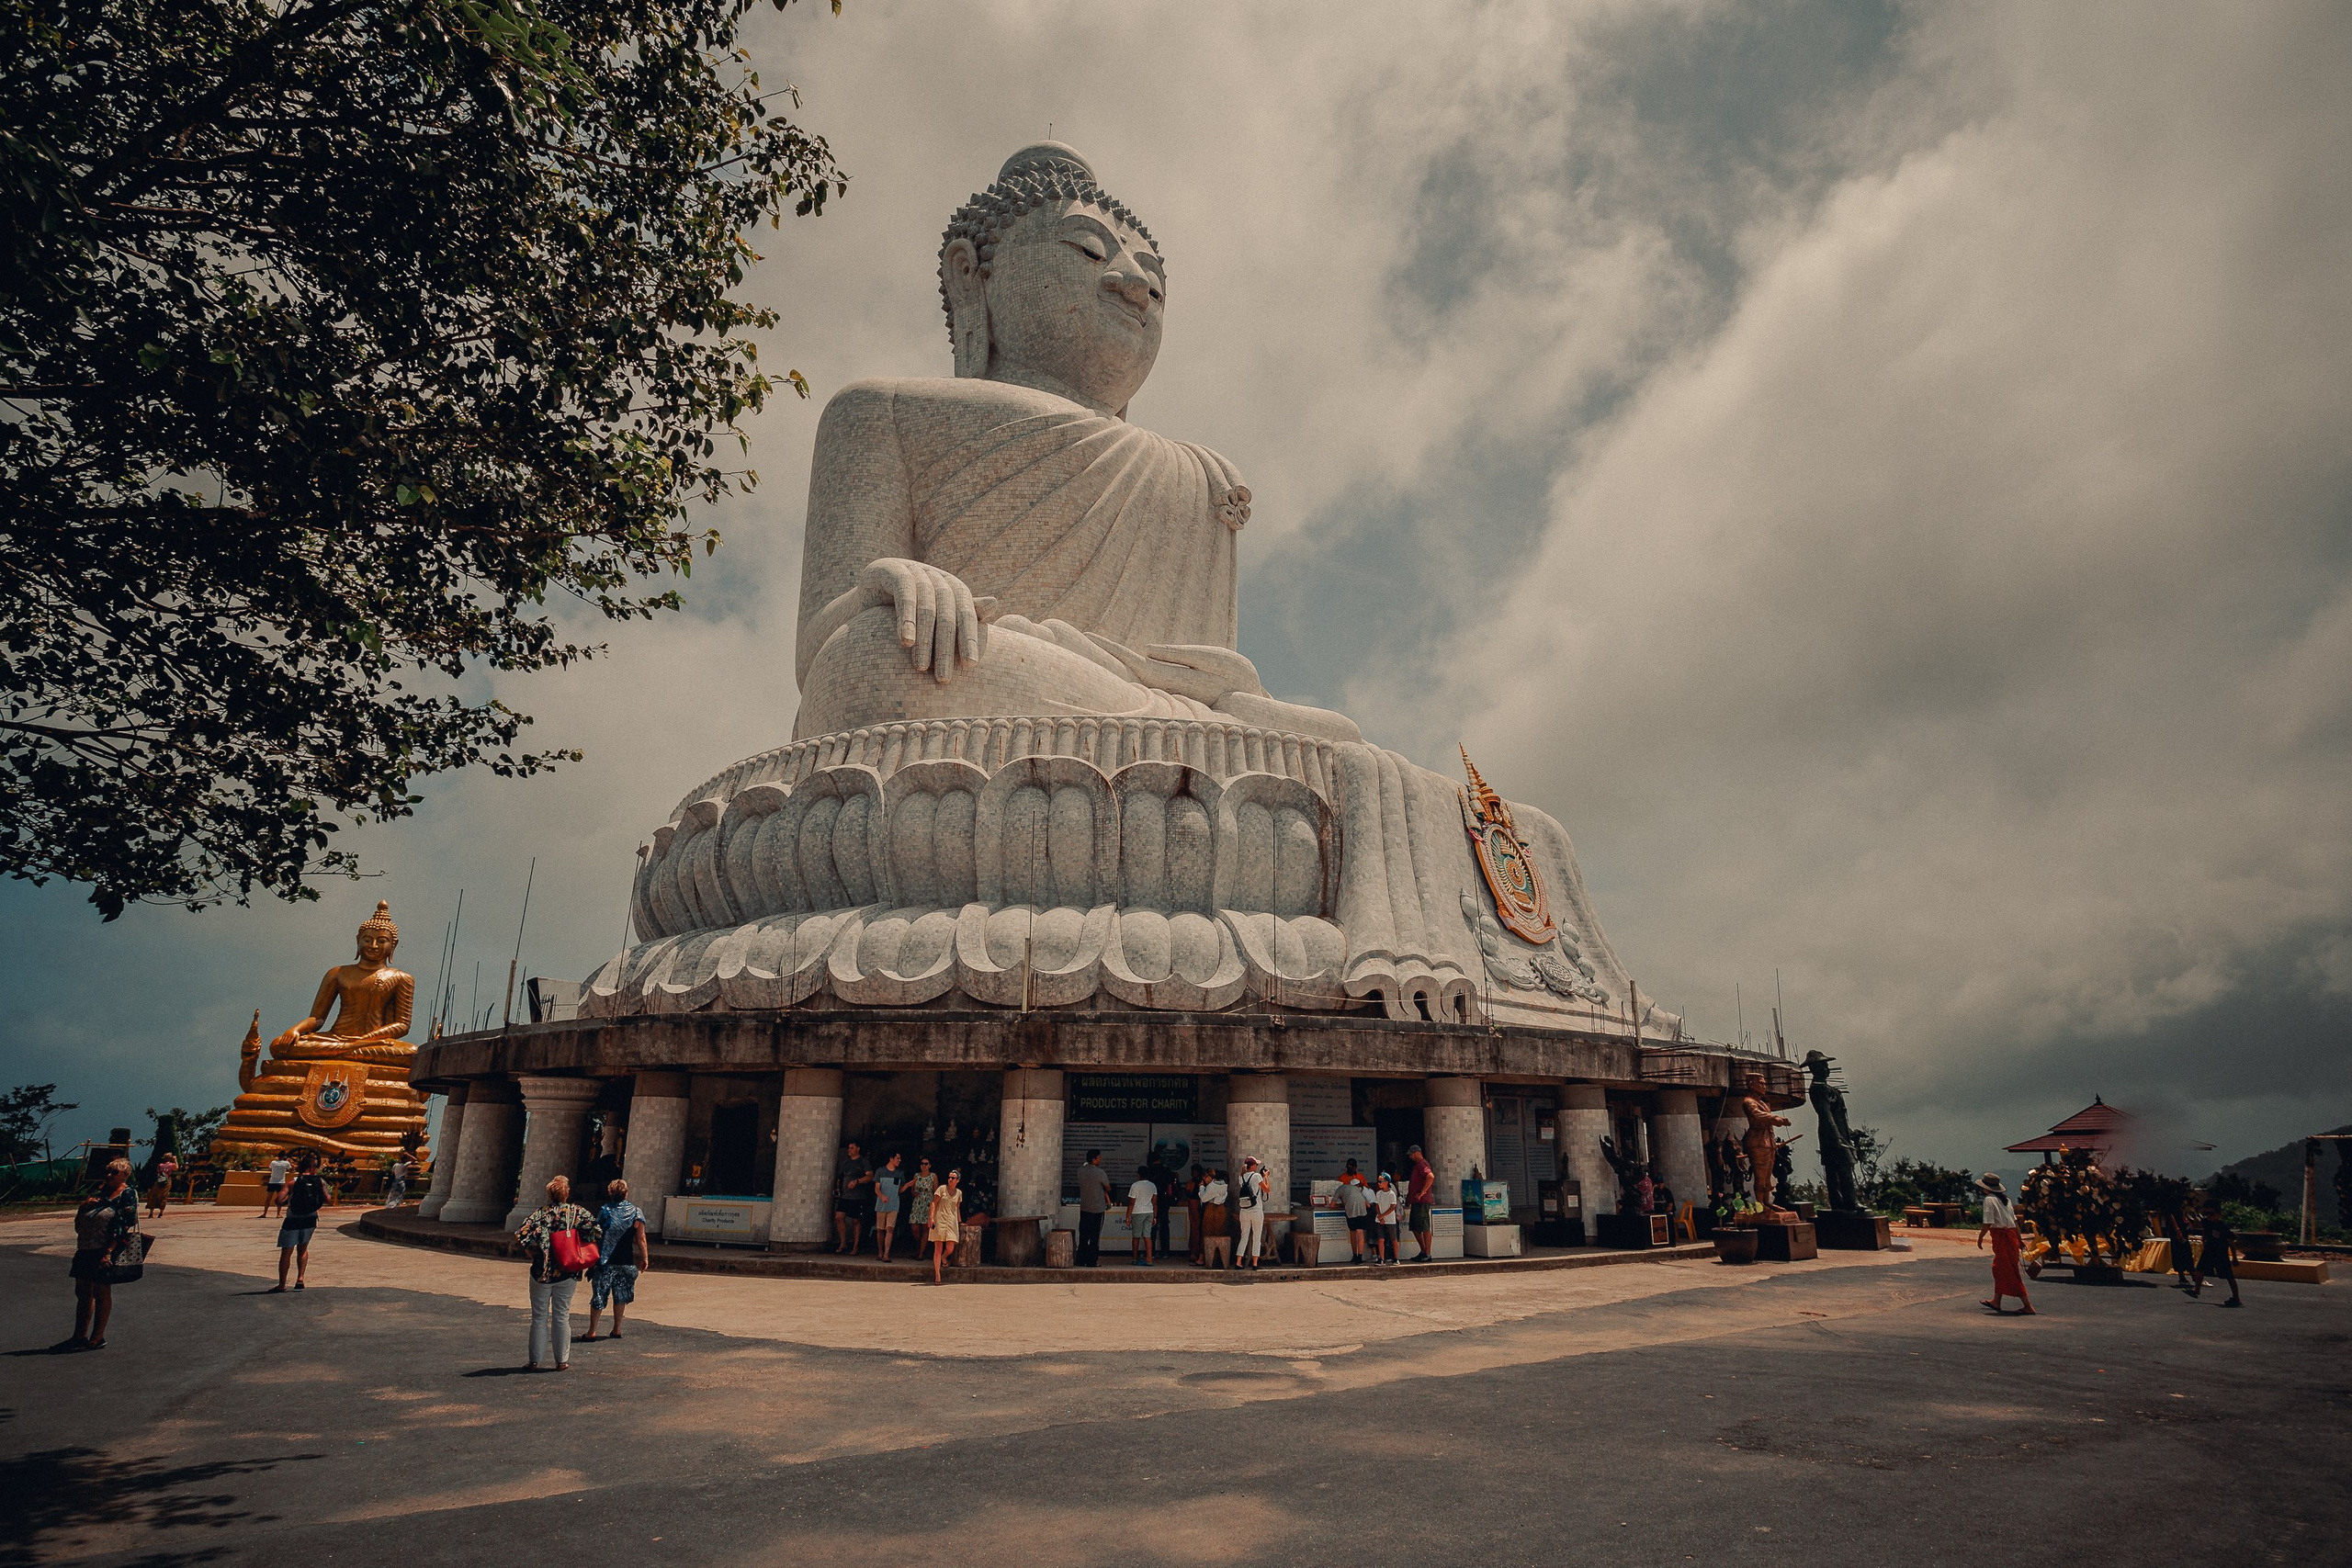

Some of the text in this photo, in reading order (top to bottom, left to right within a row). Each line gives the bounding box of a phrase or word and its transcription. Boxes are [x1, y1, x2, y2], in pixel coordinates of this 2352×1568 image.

[1080, 1098, 1189, 1109] PRODUCTS FOR CHARITY
